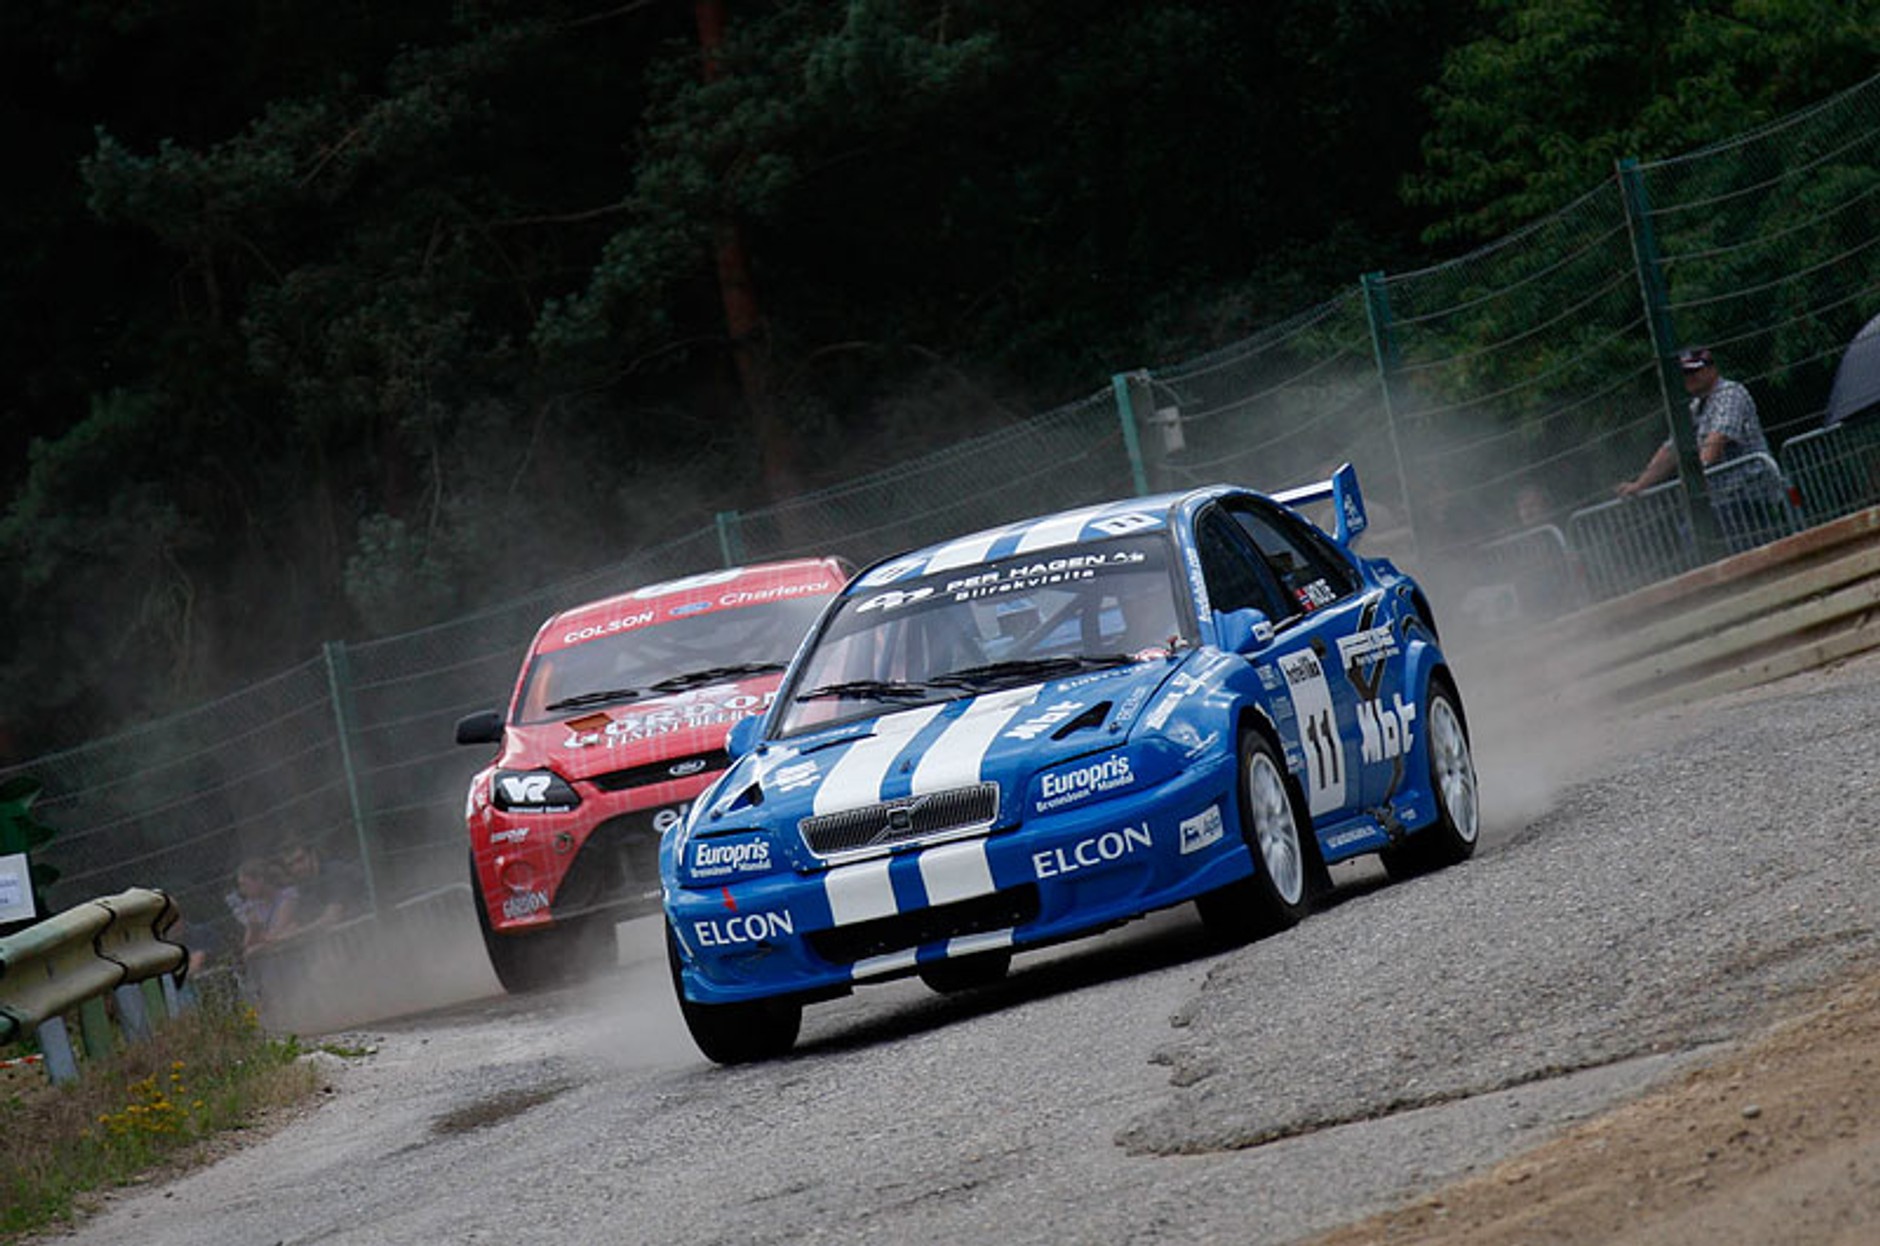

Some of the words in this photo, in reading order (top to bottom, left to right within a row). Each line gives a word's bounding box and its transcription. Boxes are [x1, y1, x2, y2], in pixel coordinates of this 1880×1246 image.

[946, 571, 999, 592] PER
[1009, 554, 1106, 579] HAGEN
[954, 569, 1094, 601] Bilrekvisita
[563, 610, 655, 644] COLSON
[719, 581, 830, 606] Charleroi
[605, 721, 679, 749] FINEST
[1306, 709, 1339, 791] 11
[1041, 754, 1130, 799] Europris
[695, 836, 770, 869] Europris
[1032, 820, 1153, 880] ELCON
[693, 909, 795, 948] ELCON
